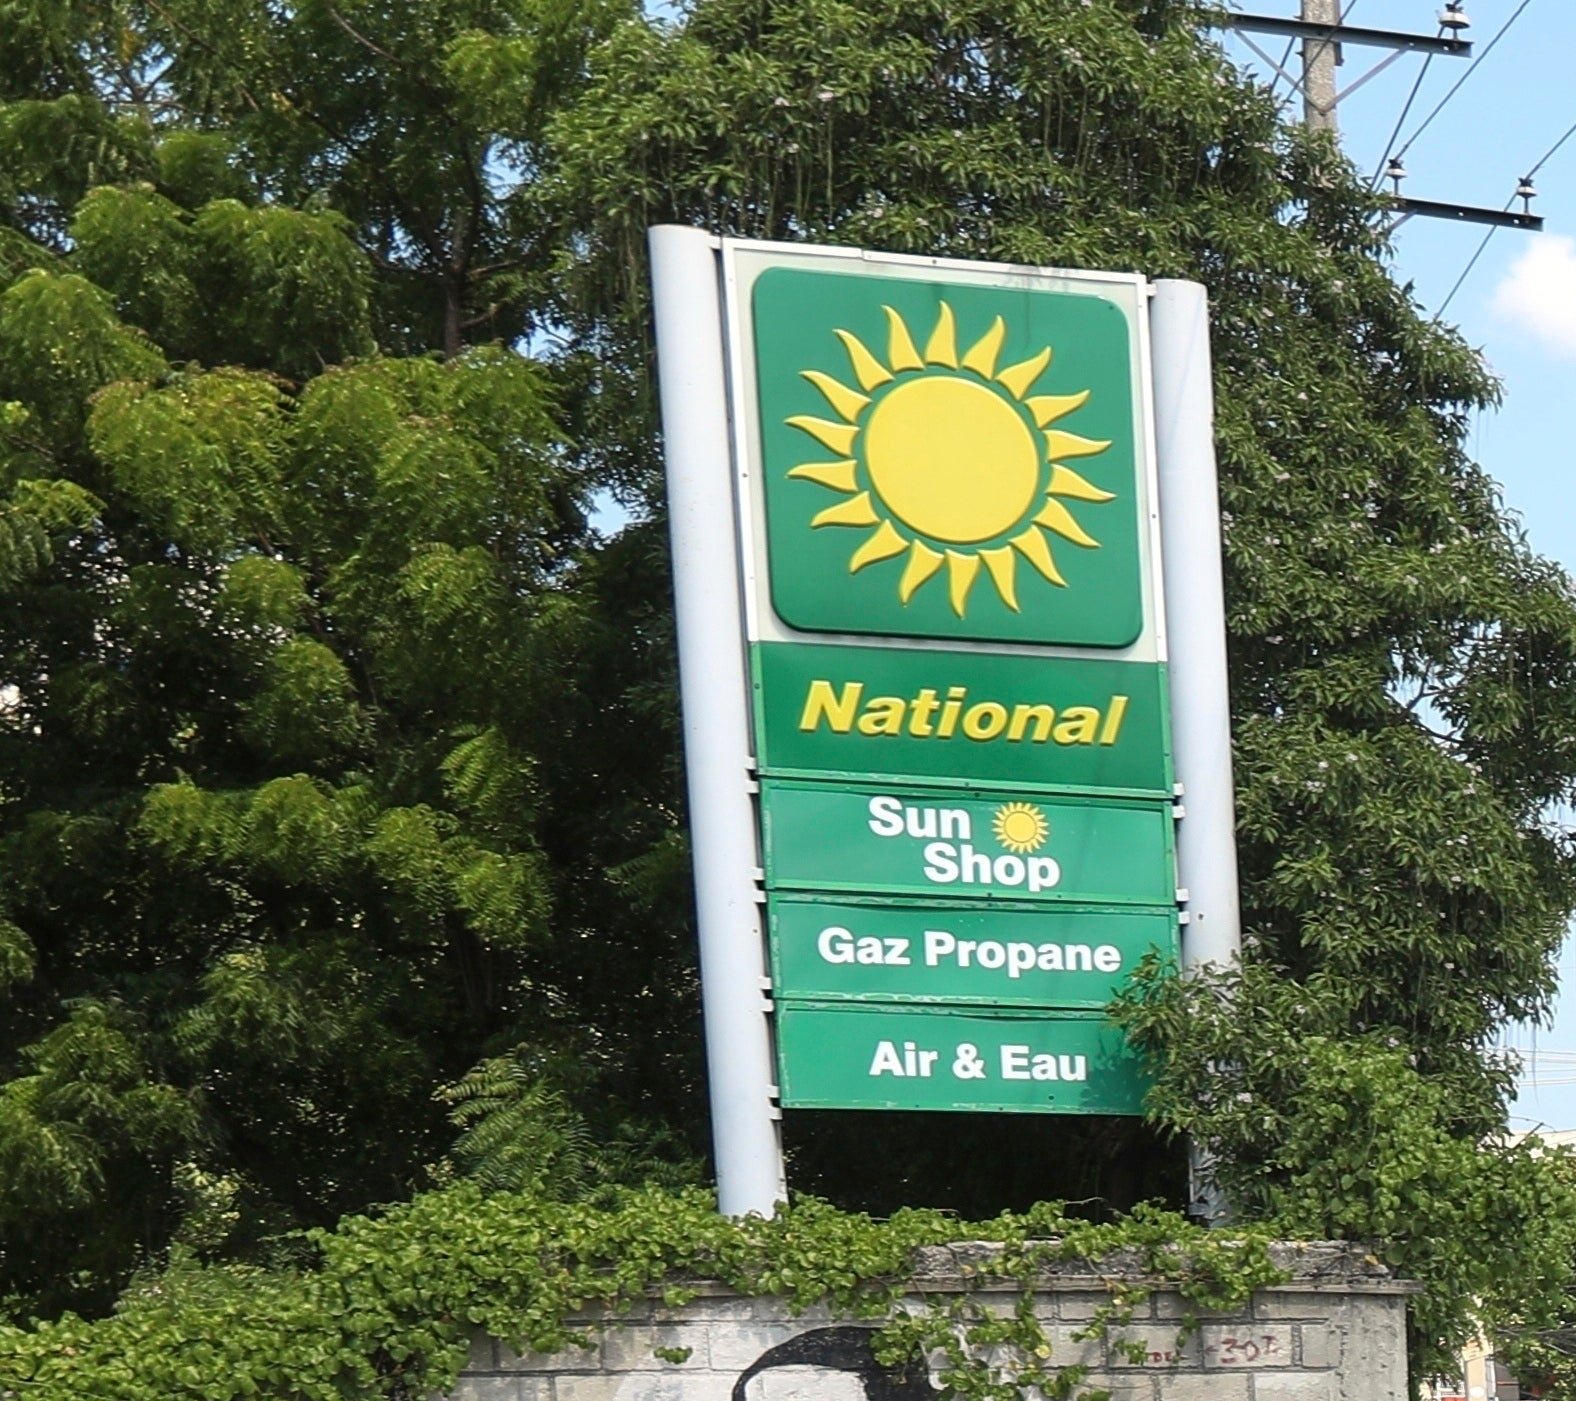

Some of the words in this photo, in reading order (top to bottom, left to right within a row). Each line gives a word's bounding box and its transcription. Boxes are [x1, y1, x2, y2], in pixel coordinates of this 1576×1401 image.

[800, 680, 1129, 748] National
[868, 798, 971, 841] Sun
[923, 841, 1060, 891] Shop
[817, 927, 910, 967] Gaz
[925, 929, 1121, 978] Propane
[869, 1040, 937, 1079] Air
[952, 1043, 987, 1081] &
[1000, 1045, 1087, 1083] Eau
